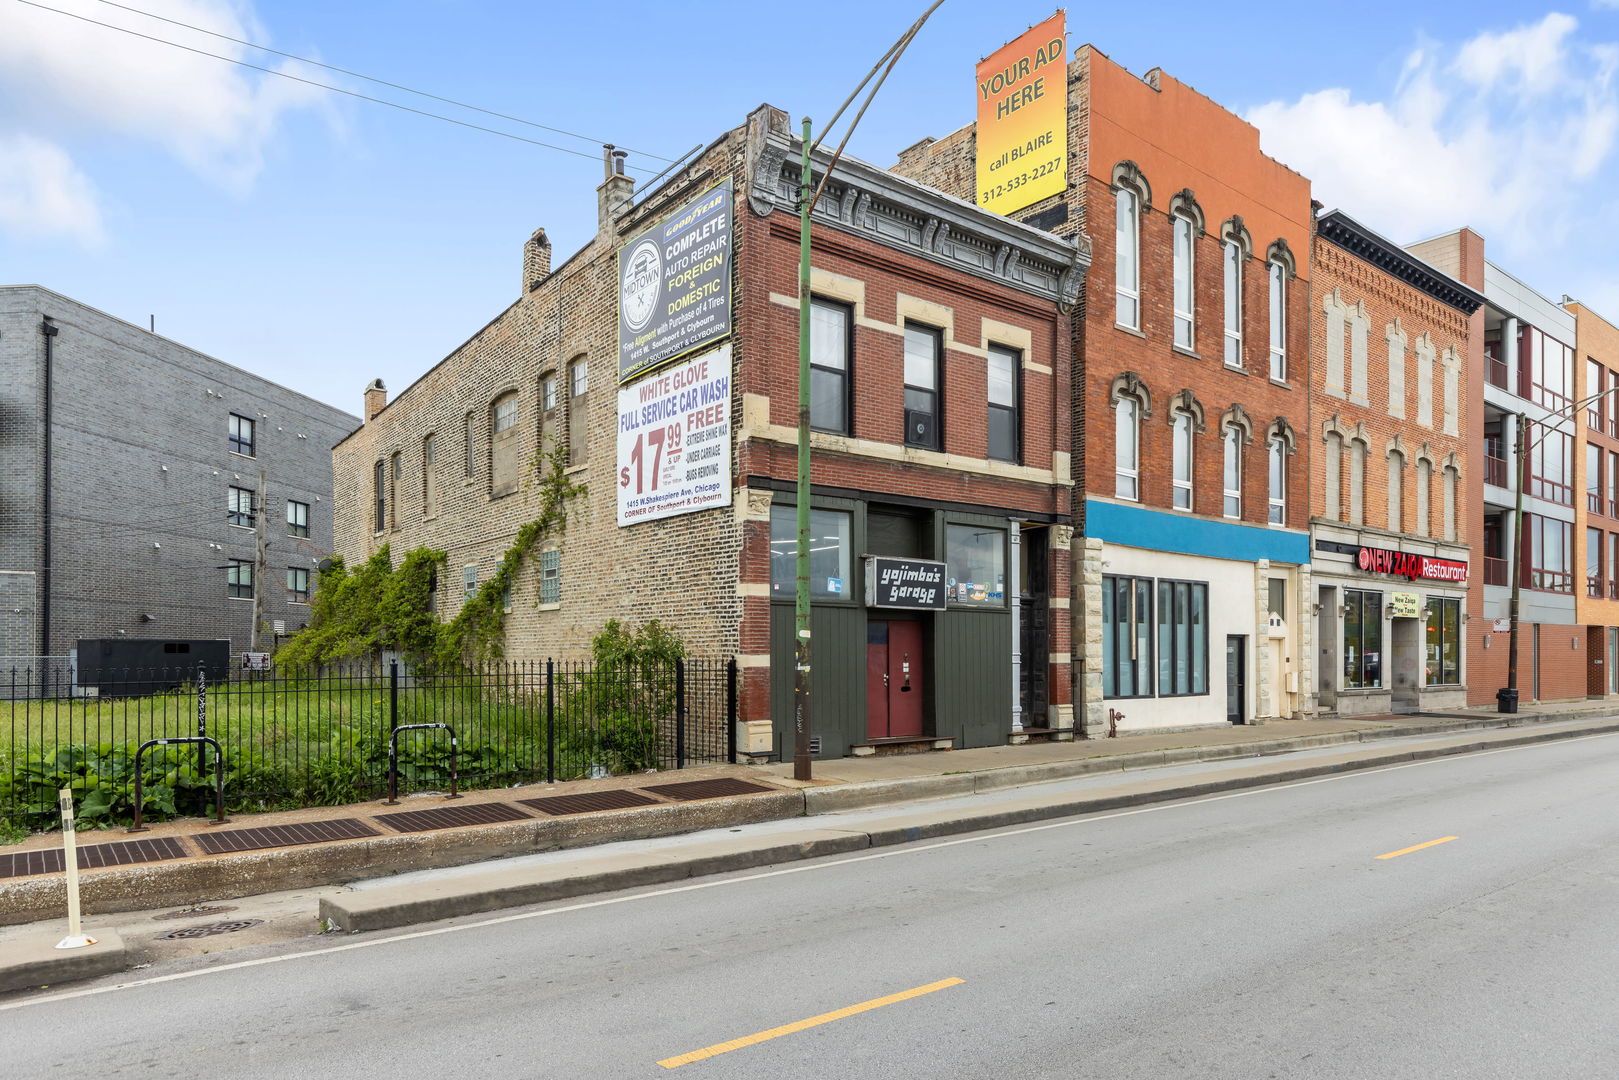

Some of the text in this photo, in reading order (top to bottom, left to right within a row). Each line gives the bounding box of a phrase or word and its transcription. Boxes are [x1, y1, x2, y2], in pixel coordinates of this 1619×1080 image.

[979, 37, 1064, 100] YOUR AD
[996, 78, 1044, 120] HERE
[989, 130, 1053, 172] call BLAIRE
[982, 157, 1062, 204] 312-533-2227
[666, 195, 723, 236] GOODYEAR
[666, 214, 726, 260] COMPLETE
[664, 235, 726, 280] AUTO REPAIR
[668, 252, 723, 292] FOREIGN
[624, 267, 659, 298] MIDTOWN
[668, 279, 720, 316] DOMESTIC
[689, 280, 696, 289] &
[656, 322, 668, 335] with
[668, 310, 694, 330] Purchase
[696, 303, 702, 316] of
[702, 302, 707, 312] 4
[708, 296, 724, 310] Tires
[622, 360, 643, 376] CORNER
[650, 341, 684, 363] SOUTHPORT
[690, 322, 726, 343] CLYBOURN
[630, 348, 643, 360] 1415
[652, 332, 680, 350] Southport
[680, 327, 686, 335] &
[686, 314, 714, 332] Clybourn
[639, 360, 708, 404] WHITE GLOVE
[620, 376, 729, 433] FULL SERVICE CAR WASH
[687, 403, 724, 432] FREE
[706, 426, 718, 441] SHINE
[719, 423, 727, 437] WAX
[673, 455, 681, 463] UP
[698, 463, 718, 478] REMOVING
[701, 444, 720, 460] CARRIAGE
[624, 507, 646, 518] CORNER
[648, 506, 656, 514] OF
[656, 500, 685, 512] Southport
[693, 493, 722, 504] Clybourn
[626, 500, 639, 508] 1415
[694, 482, 720, 494] Chicago
[1369, 548, 1466, 581] NEW ZAIQA Restaurant
[889, 586, 936, 603] garage
